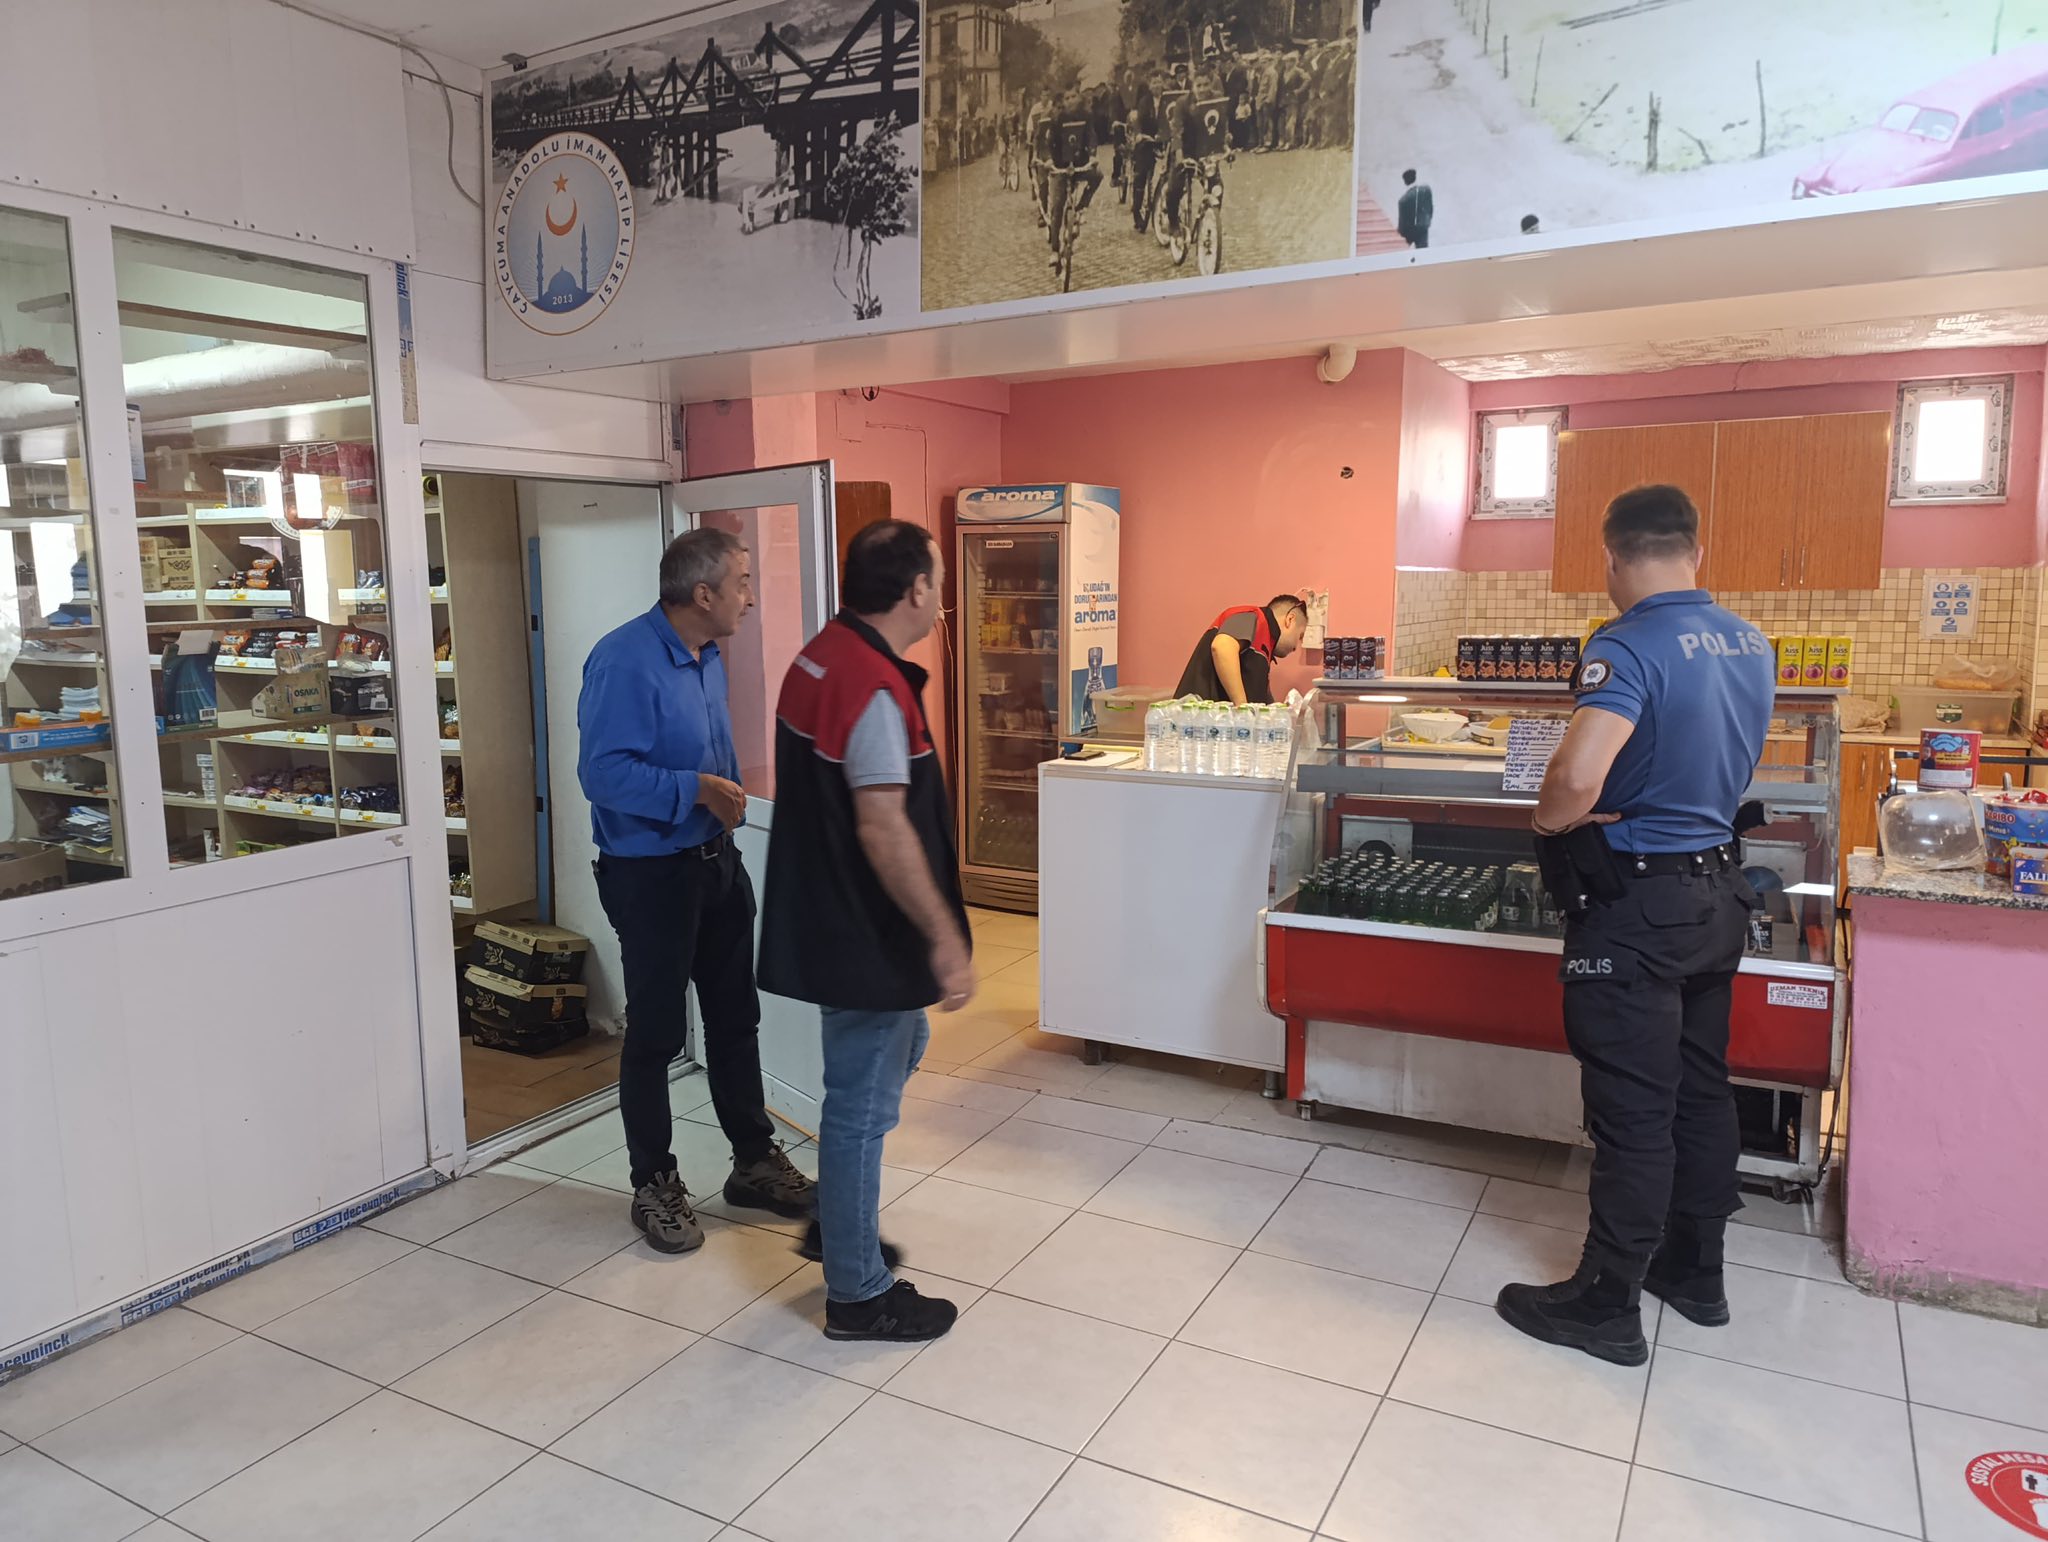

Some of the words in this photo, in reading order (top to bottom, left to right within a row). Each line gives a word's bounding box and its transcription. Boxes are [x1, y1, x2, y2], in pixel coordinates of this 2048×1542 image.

[566, 135, 607, 165] İMAM
[502, 142, 559, 215] ANADOLU
[608, 164, 632, 227] HATİP
[497, 225, 528, 314] ÇAYCUMA
[598, 238, 630, 306] LİSESİ
[552, 295, 573, 305] 2013
[981, 490, 1055, 502] aroma
[1075, 609, 1116, 624] aroma
[1677, 631, 1765, 659] POLİS
[294, 688, 319, 697] OSAKA
[2020, 871, 2048, 882] FALI
[295, 1223, 317, 1242] EGE
[343, 1187, 400, 1220] deceuninck
[1971, 1456, 2004, 1486] SOSYAL
[1997, 1453, 2048, 1466] MESA
